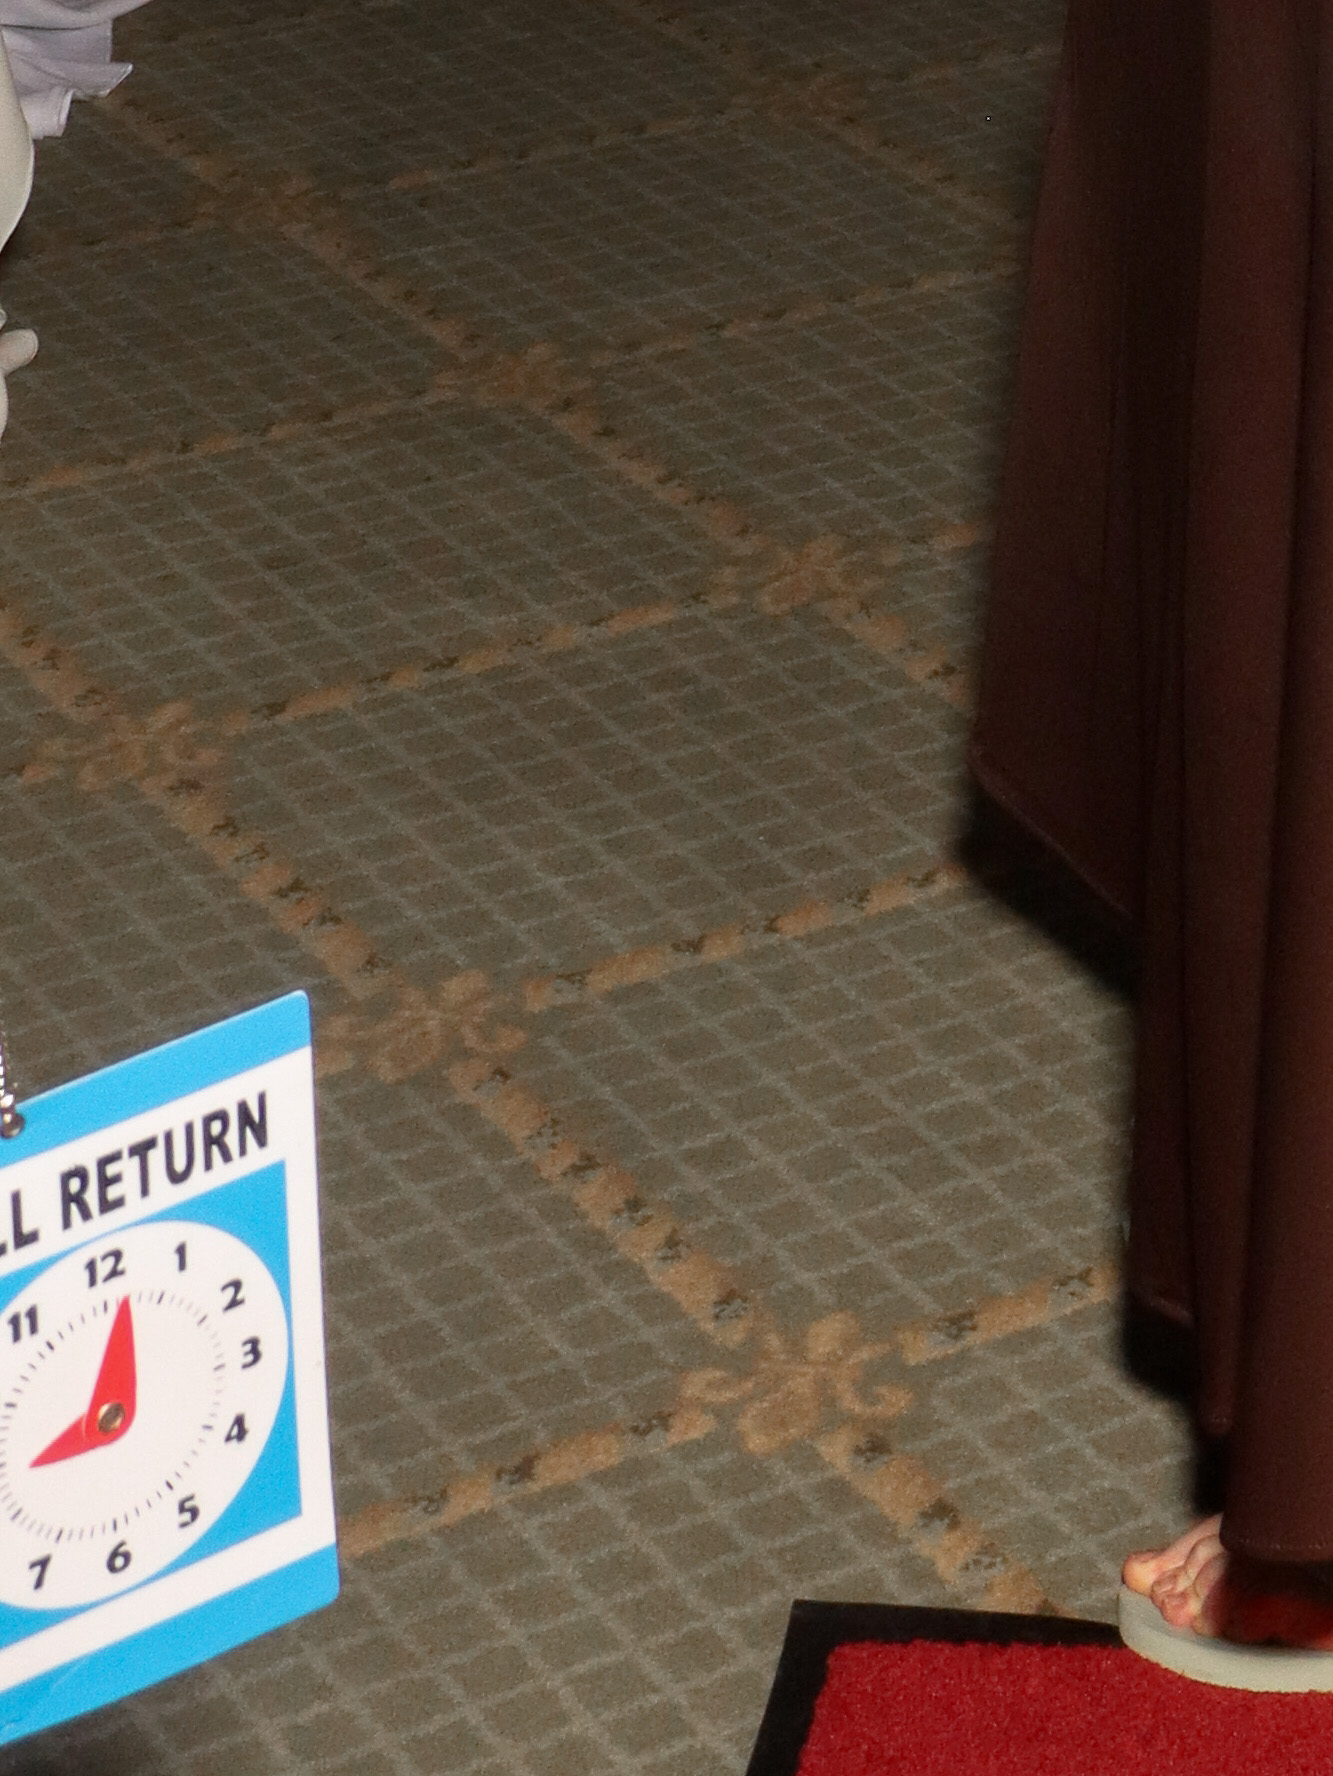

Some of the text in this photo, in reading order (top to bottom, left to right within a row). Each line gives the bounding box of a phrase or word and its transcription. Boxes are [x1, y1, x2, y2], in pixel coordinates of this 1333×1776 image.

[0, 1090, 269, 1258] L RETURN
[84, 1248, 126, 1289] 12
[174, 1242, 188, 1273] 1
[220, 1278, 246, 1312] 2
[7, 1304, 40, 1345] 11
[240, 1336, 263, 1370] 3
[223, 1413, 249, 1447] 4
[177, 1496, 200, 1531] 5
[28, 1554, 52, 1591] 7
[105, 1540, 132, 1576] 6
